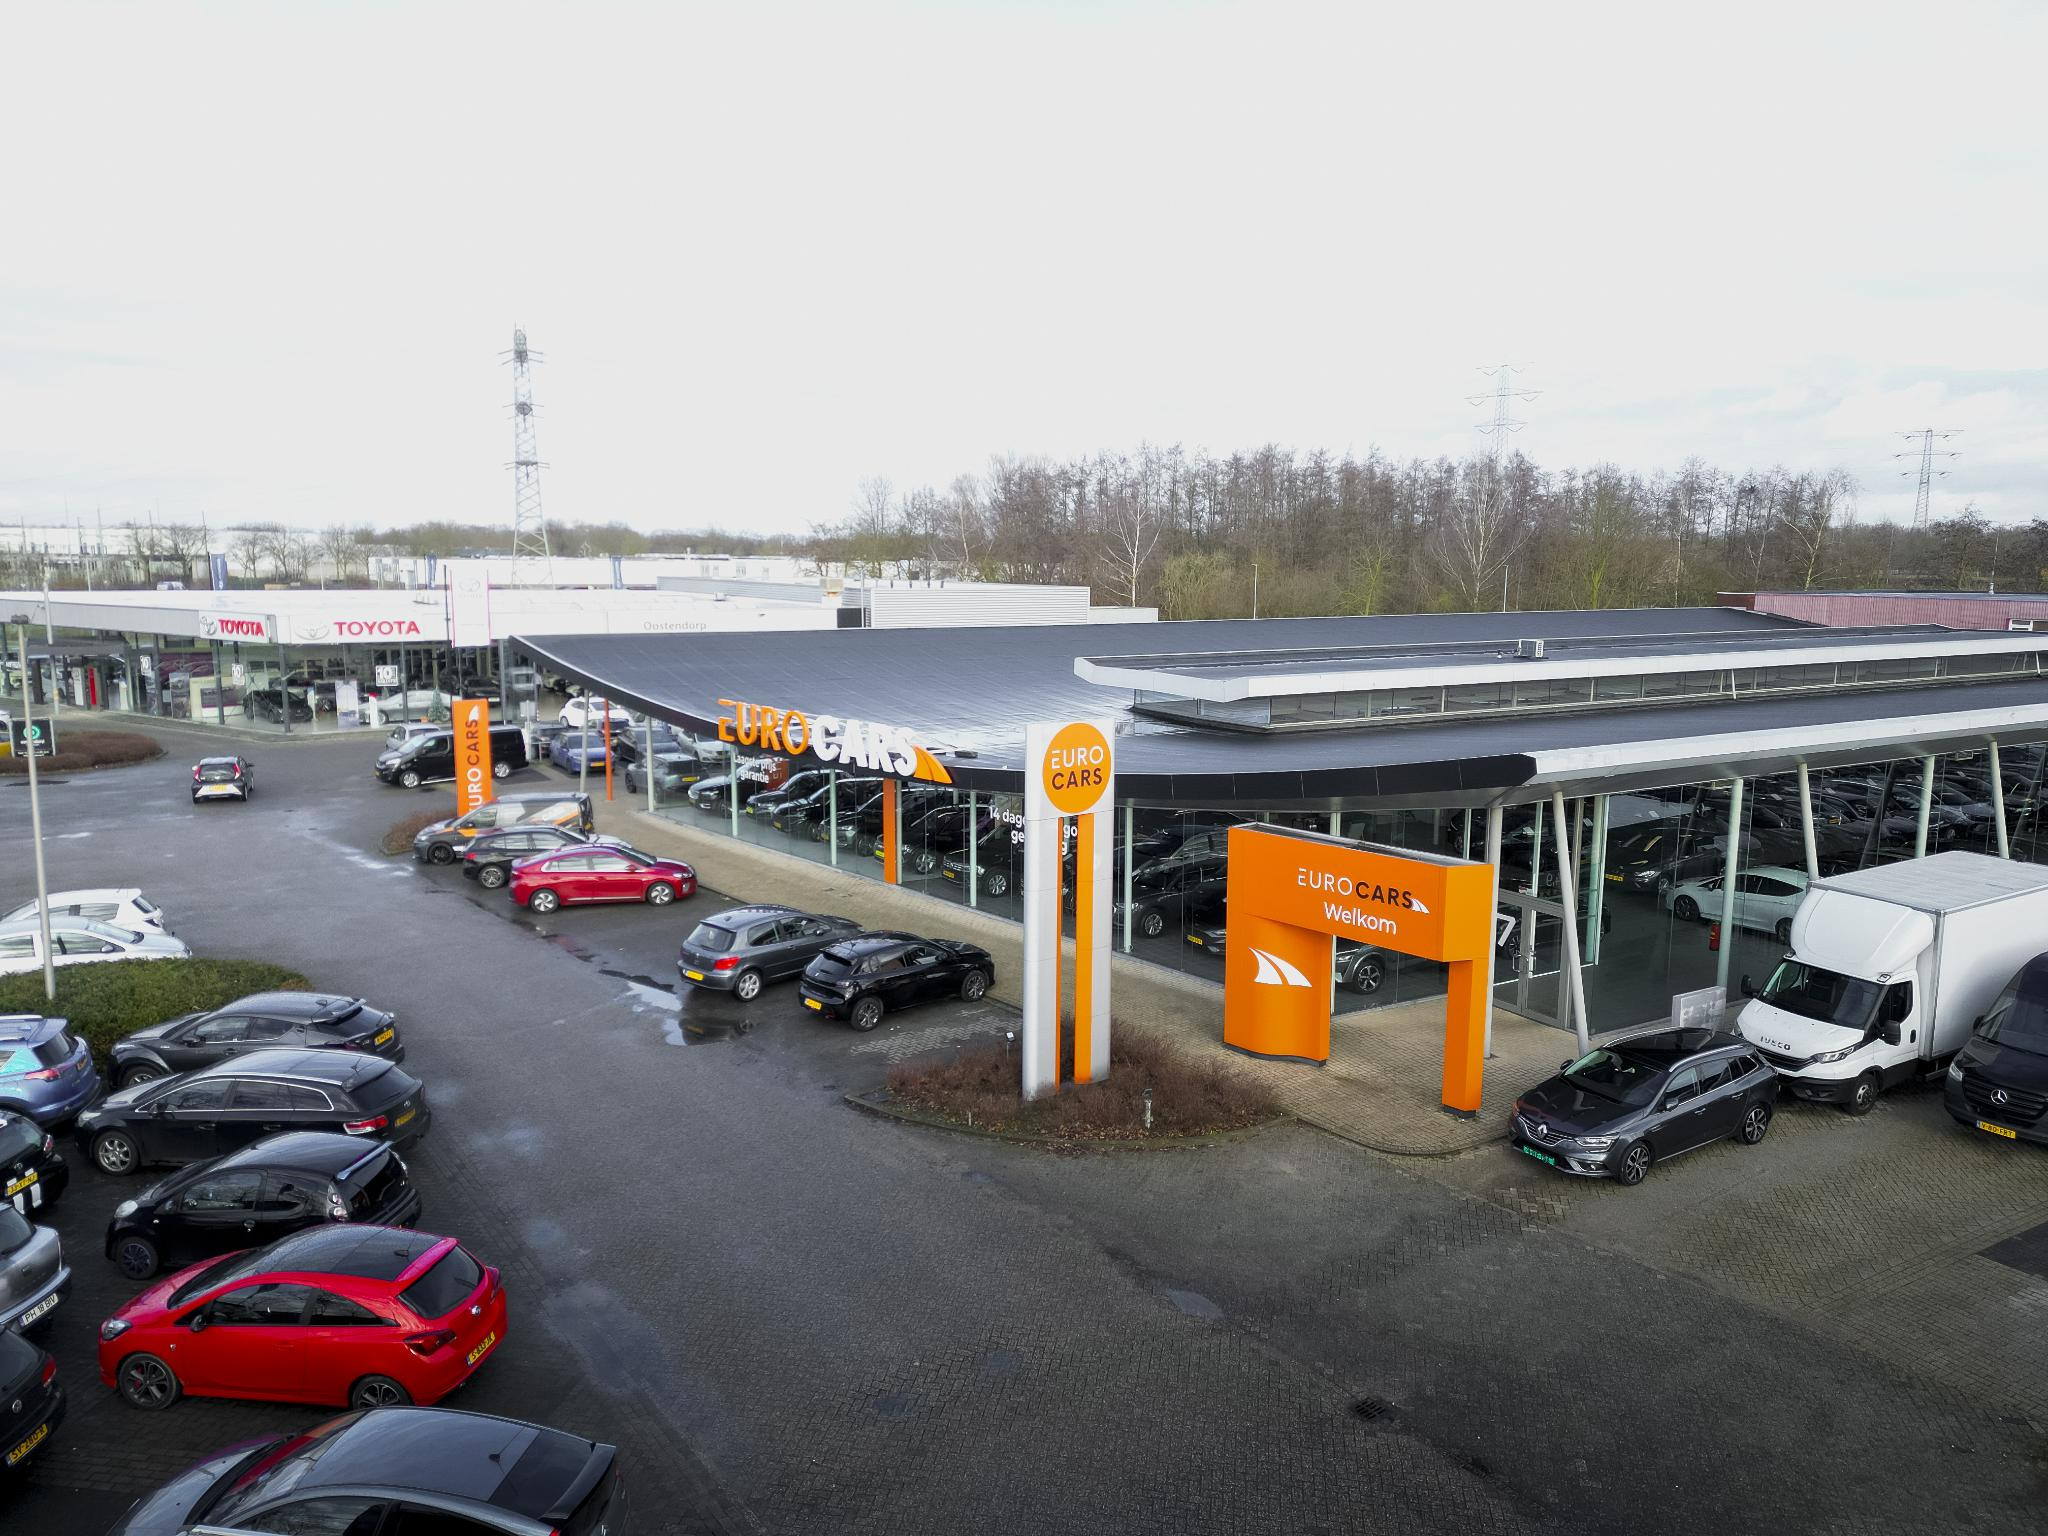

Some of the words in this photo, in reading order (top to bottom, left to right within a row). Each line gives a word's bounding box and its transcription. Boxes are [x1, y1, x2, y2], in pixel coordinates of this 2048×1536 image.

[218, 619, 264, 636] TOYOTA
[334, 621, 420, 635] TOYOTA
[718, 698, 918, 777] EUROCARS
[465, 720, 483, 812] UROCARS
[760, 759, 777, 773] prijs
[1051, 745, 1104, 769] EURO
[740, 769, 769, 784] garantie
[1051, 768, 1103, 790] CARS
[989, 806, 1000, 820] 14
[1297, 867, 1413, 909] EUROCARS
[1324, 901, 1397, 935] Welkom
[1760, 1036, 1791, 1050] IVECO
